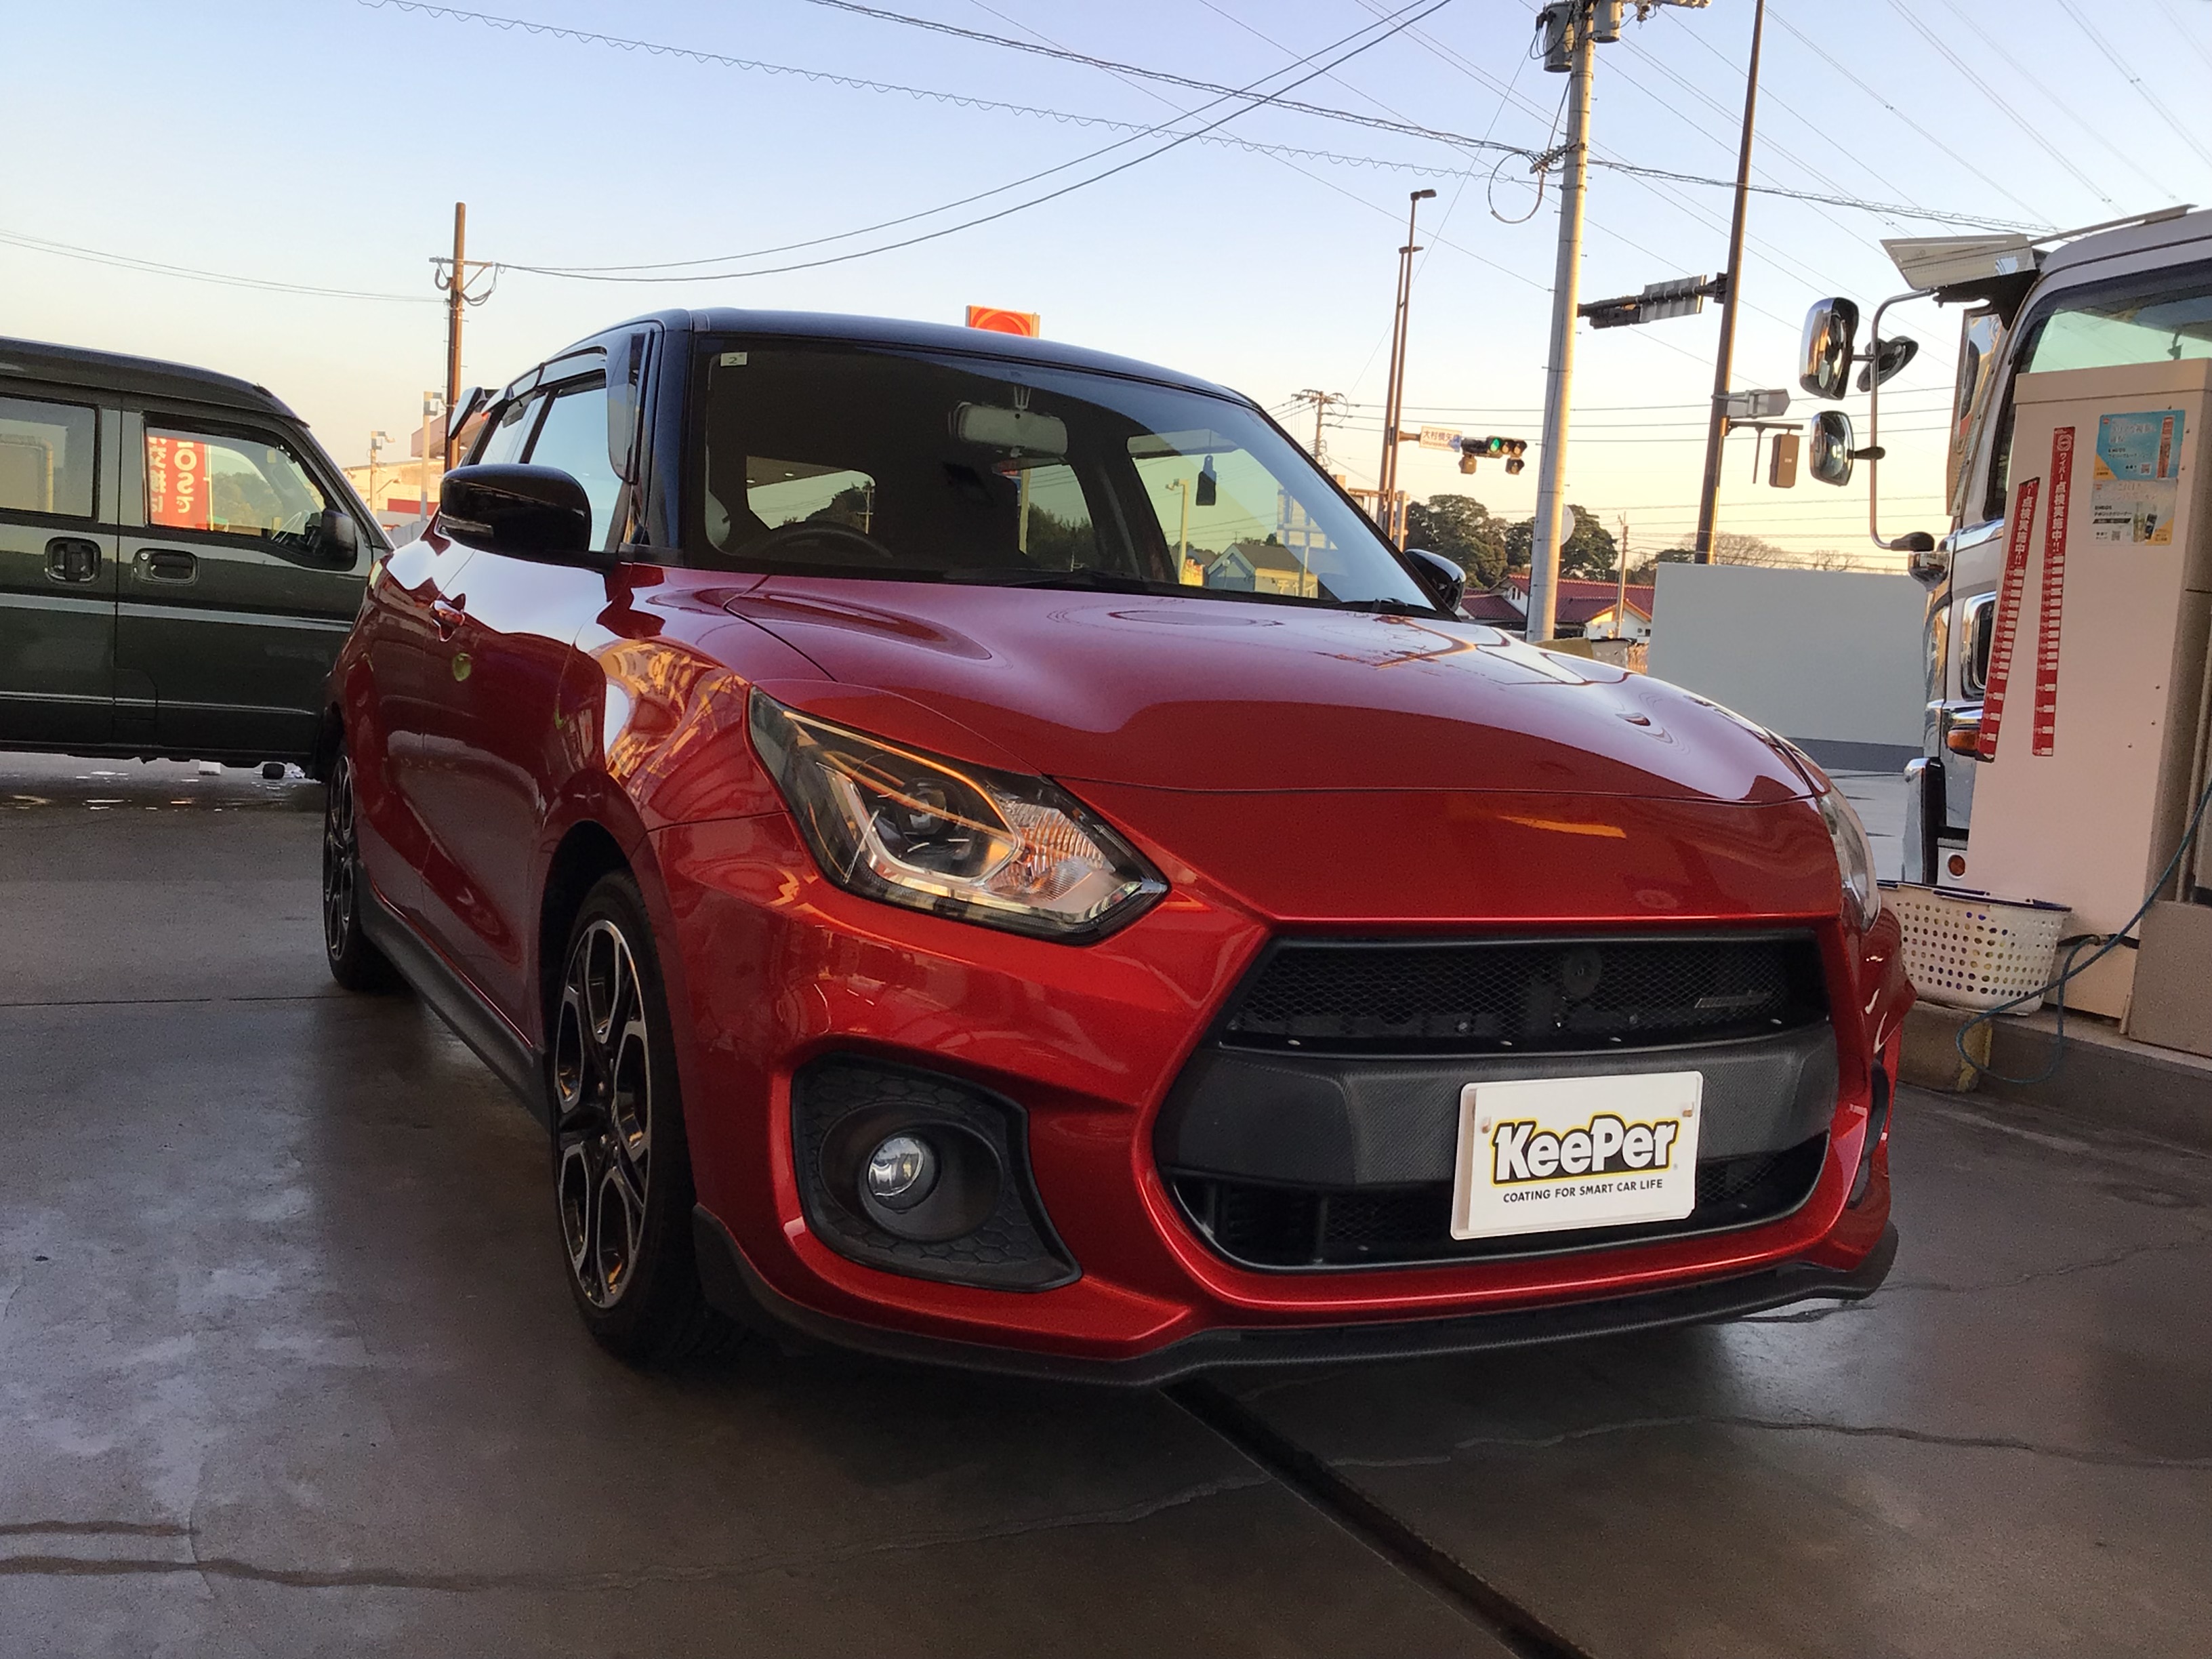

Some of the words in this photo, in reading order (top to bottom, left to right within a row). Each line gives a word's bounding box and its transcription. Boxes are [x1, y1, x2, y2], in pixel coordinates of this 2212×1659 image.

[1494, 1115, 1678, 1183] KeePer
[1503, 1189, 1551, 1203] COATING
[1555, 1187, 1576, 1197] FOR
[1579, 1184, 1613, 1195] SMART
[1617, 1181, 1637, 1191] CAR
[1640, 1179, 1663, 1189] LIFE
